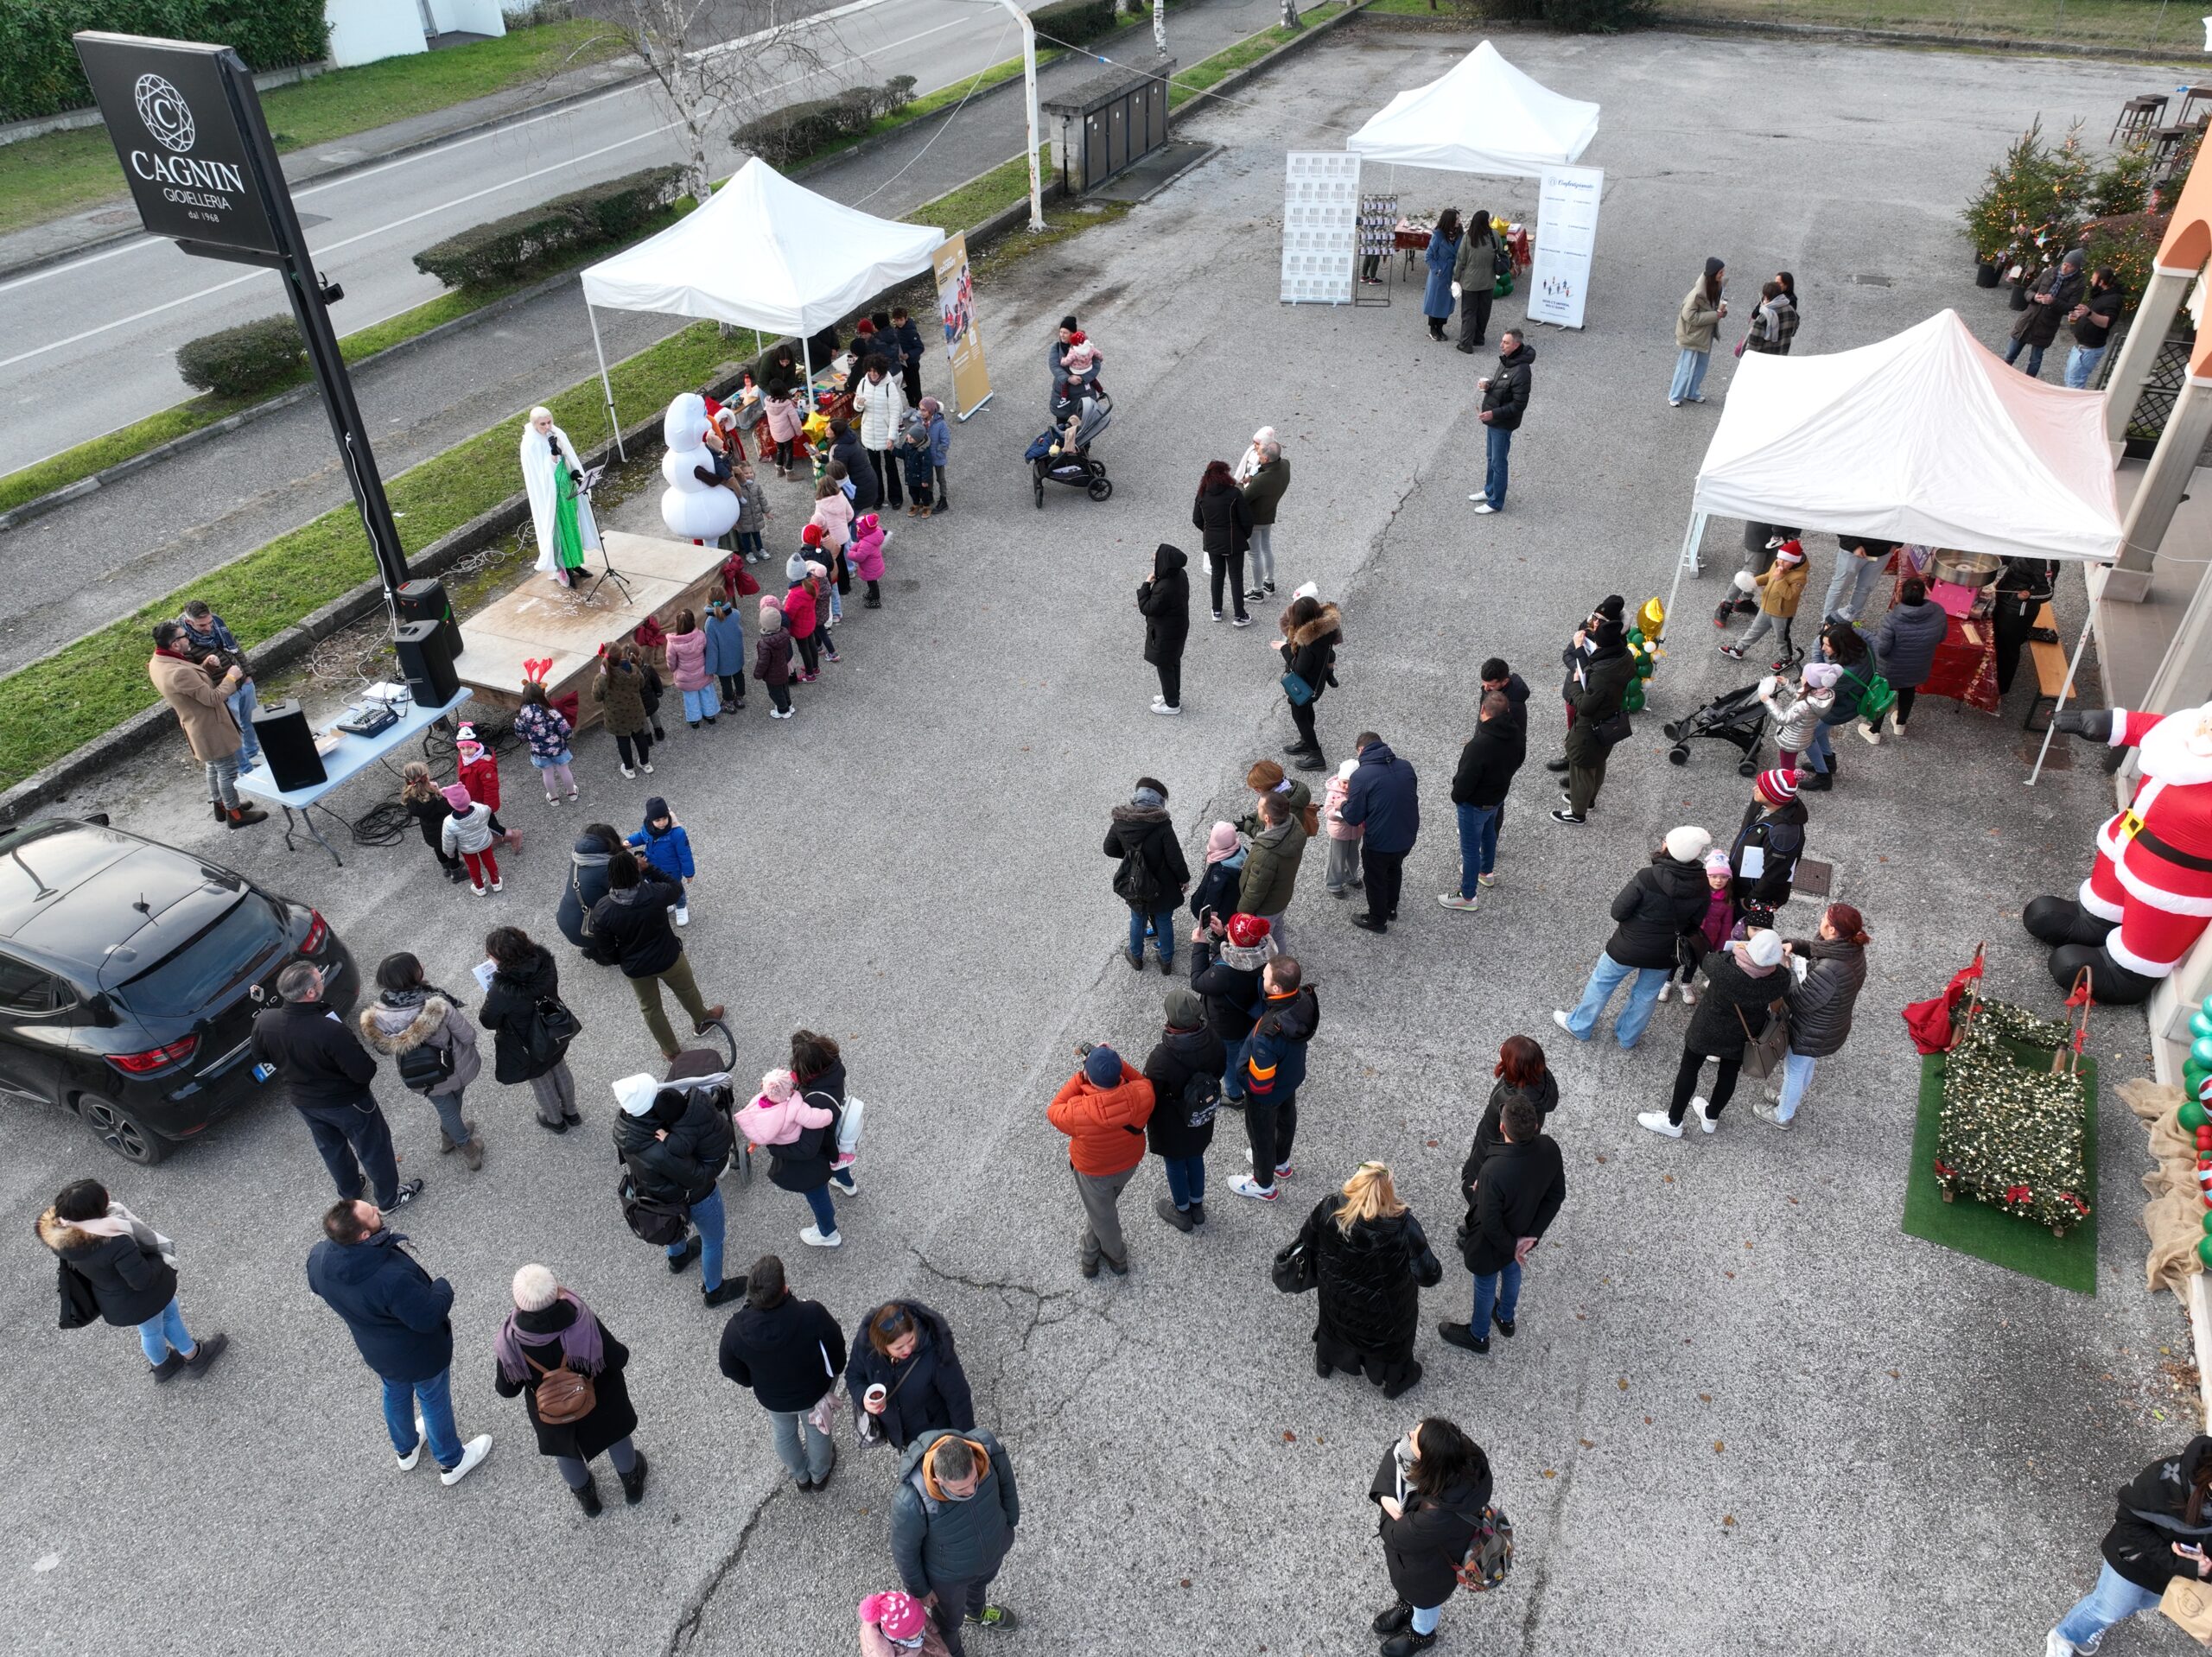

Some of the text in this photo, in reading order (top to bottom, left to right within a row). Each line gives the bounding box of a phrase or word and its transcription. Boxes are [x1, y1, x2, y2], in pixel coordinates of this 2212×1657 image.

[154, 98, 177, 129] C
[131, 150, 245, 194] CAGNIN
[163, 187, 233, 211] GIOIELLERIA
[188, 210, 220, 223] dal 1968
[251, 995, 278, 1019] CLIO
